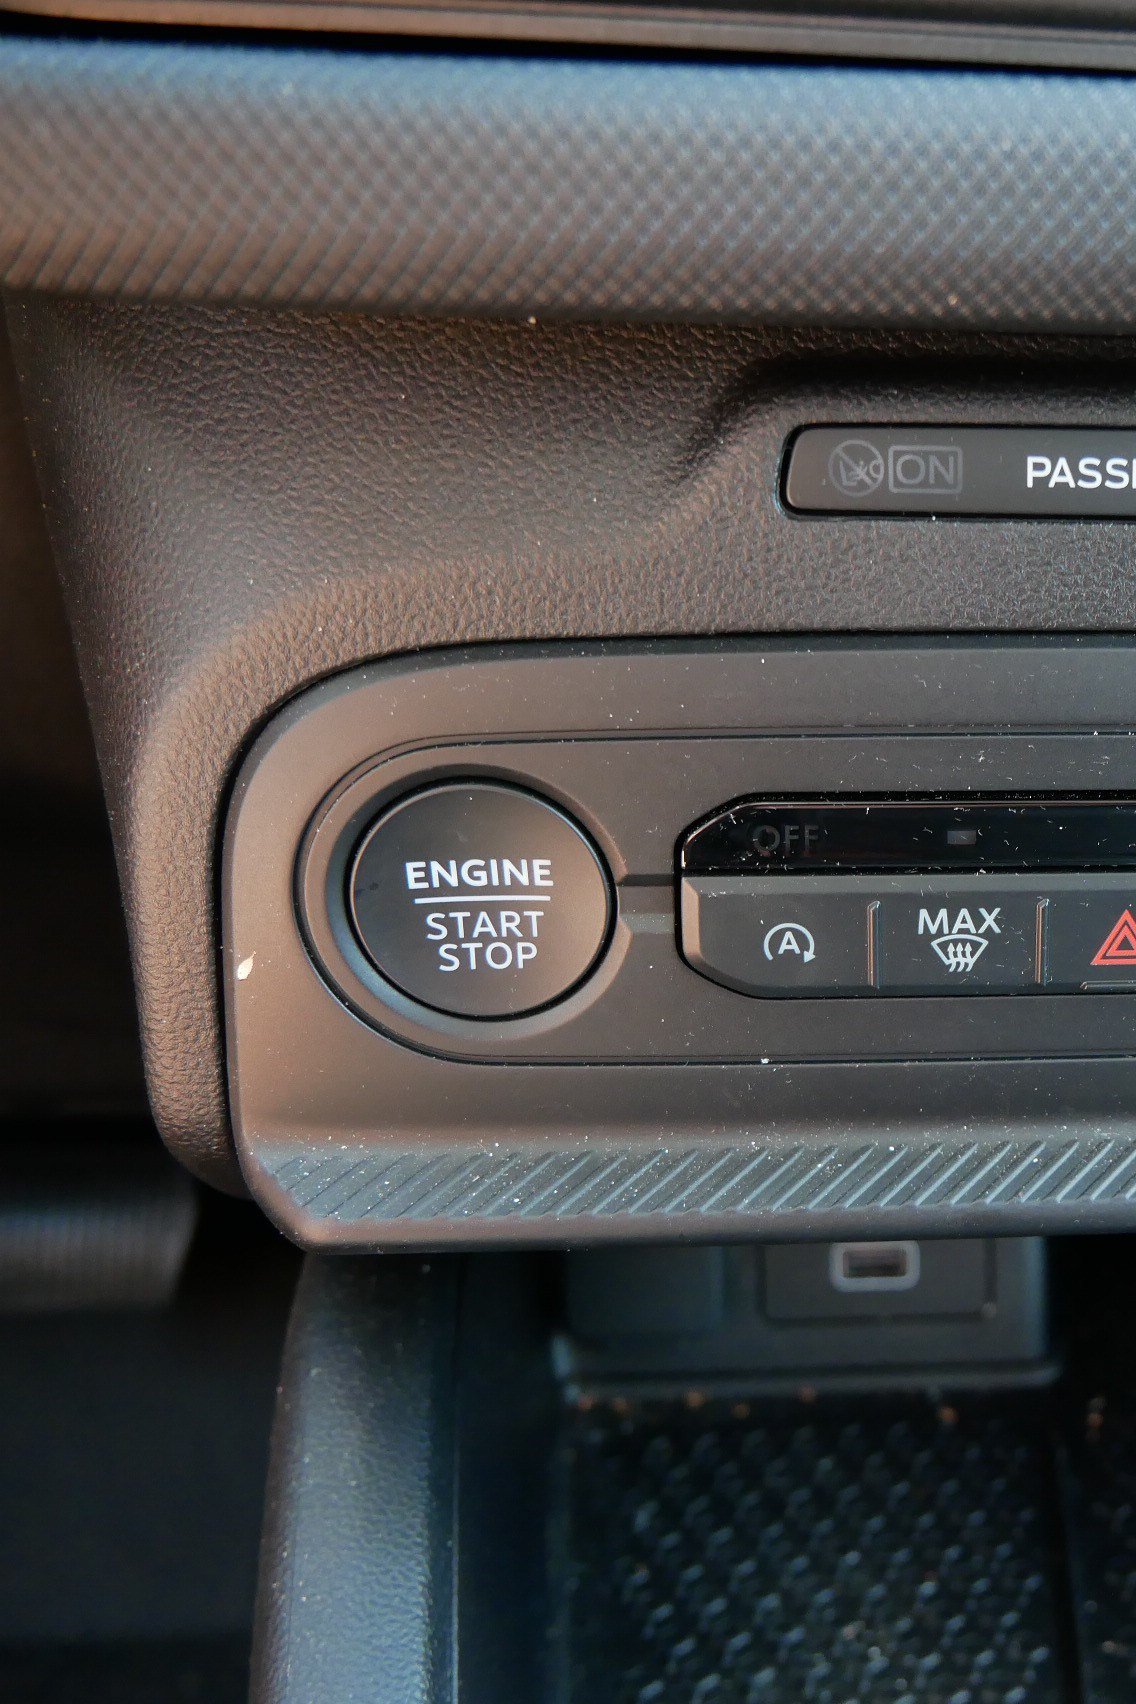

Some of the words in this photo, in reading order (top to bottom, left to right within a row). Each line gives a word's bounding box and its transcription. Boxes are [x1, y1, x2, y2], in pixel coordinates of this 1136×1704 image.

[896, 454, 954, 485] ON
[753, 825, 819, 854] OFF
[405, 859, 552, 888] ENGINE
[426, 911, 543, 938] START
[918, 908, 1000, 933] MAX
[439, 942, 536, 969] STOP
[778, 931, 799, 953] A
